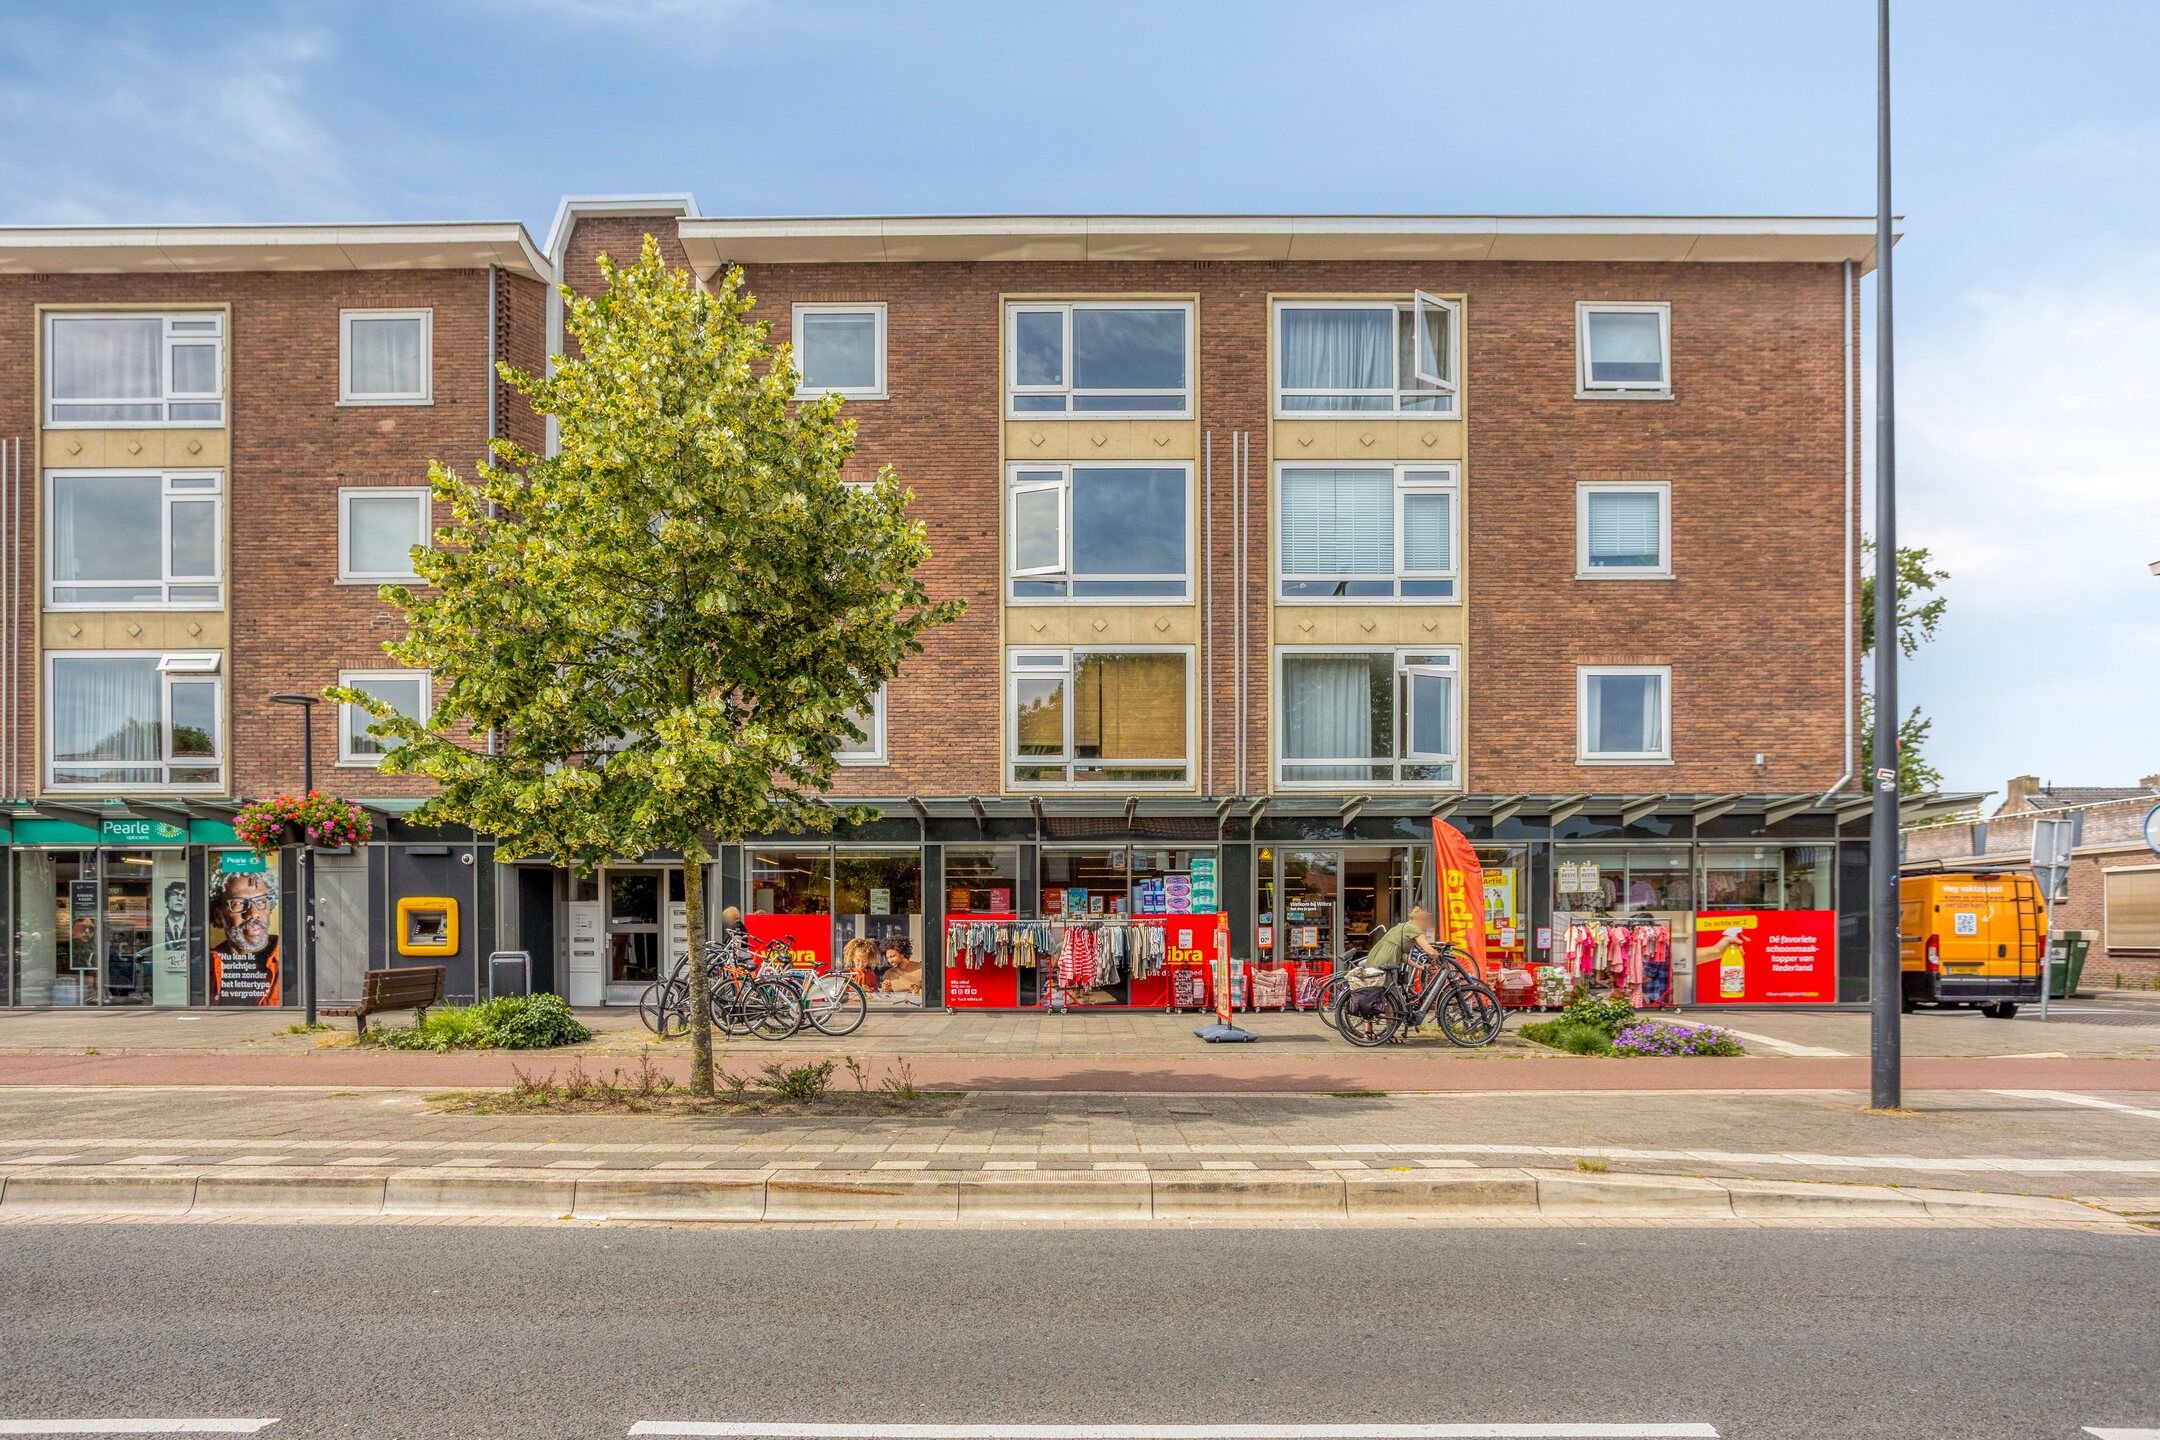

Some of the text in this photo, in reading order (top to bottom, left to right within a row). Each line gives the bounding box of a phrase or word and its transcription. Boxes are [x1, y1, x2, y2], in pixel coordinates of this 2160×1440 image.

[103, 821, 150, 834] Pearle
[1769, 935, 1817, 944] Dé favoriete
[1167, 946, 1203, 962] ibra
[1771, 955, 1798, 963] topper
[221, 962, 257, 971] berichtjes
[1772, 964, 1813, 972] Nederland
[235, 980, 271, 989] lettertype
